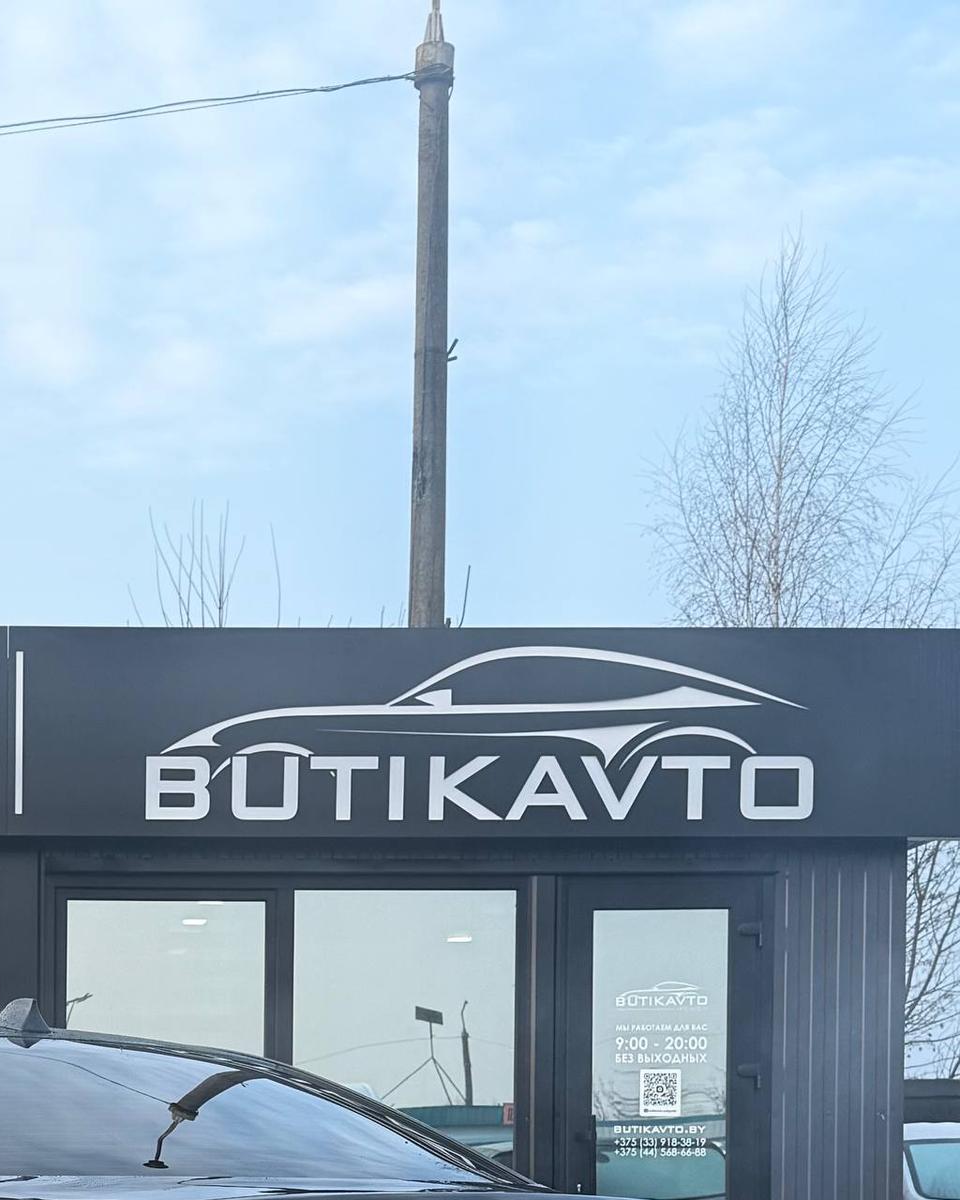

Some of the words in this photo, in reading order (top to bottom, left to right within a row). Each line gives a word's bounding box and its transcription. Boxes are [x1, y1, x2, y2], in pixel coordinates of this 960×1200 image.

[145, 755, 814, 821] BUTIKAVTO
[615, 995, 708, 1007] BUTIKAVTO
[615, 1036, 649, 1051] 9:00
[664, 1036, 708, 1050] 20:00
[615, 1053, 635, 1064] БЕЗ
[637, 1053, 708, 1065] ВЫХОДНЫХ
[613, 1125, 707, 1134] BUTIKAVTO.BY
[614, 1137, 638, 1147] +375
[640, 1136, 658, 1150] (33)
[660, 1137, 707, 1147] 918-38-19
[614, 1147, 638, 1157] +375
[640, 1146, 658, 1159] (44)
[660, 1147, 707, 1157] 568-66-88
